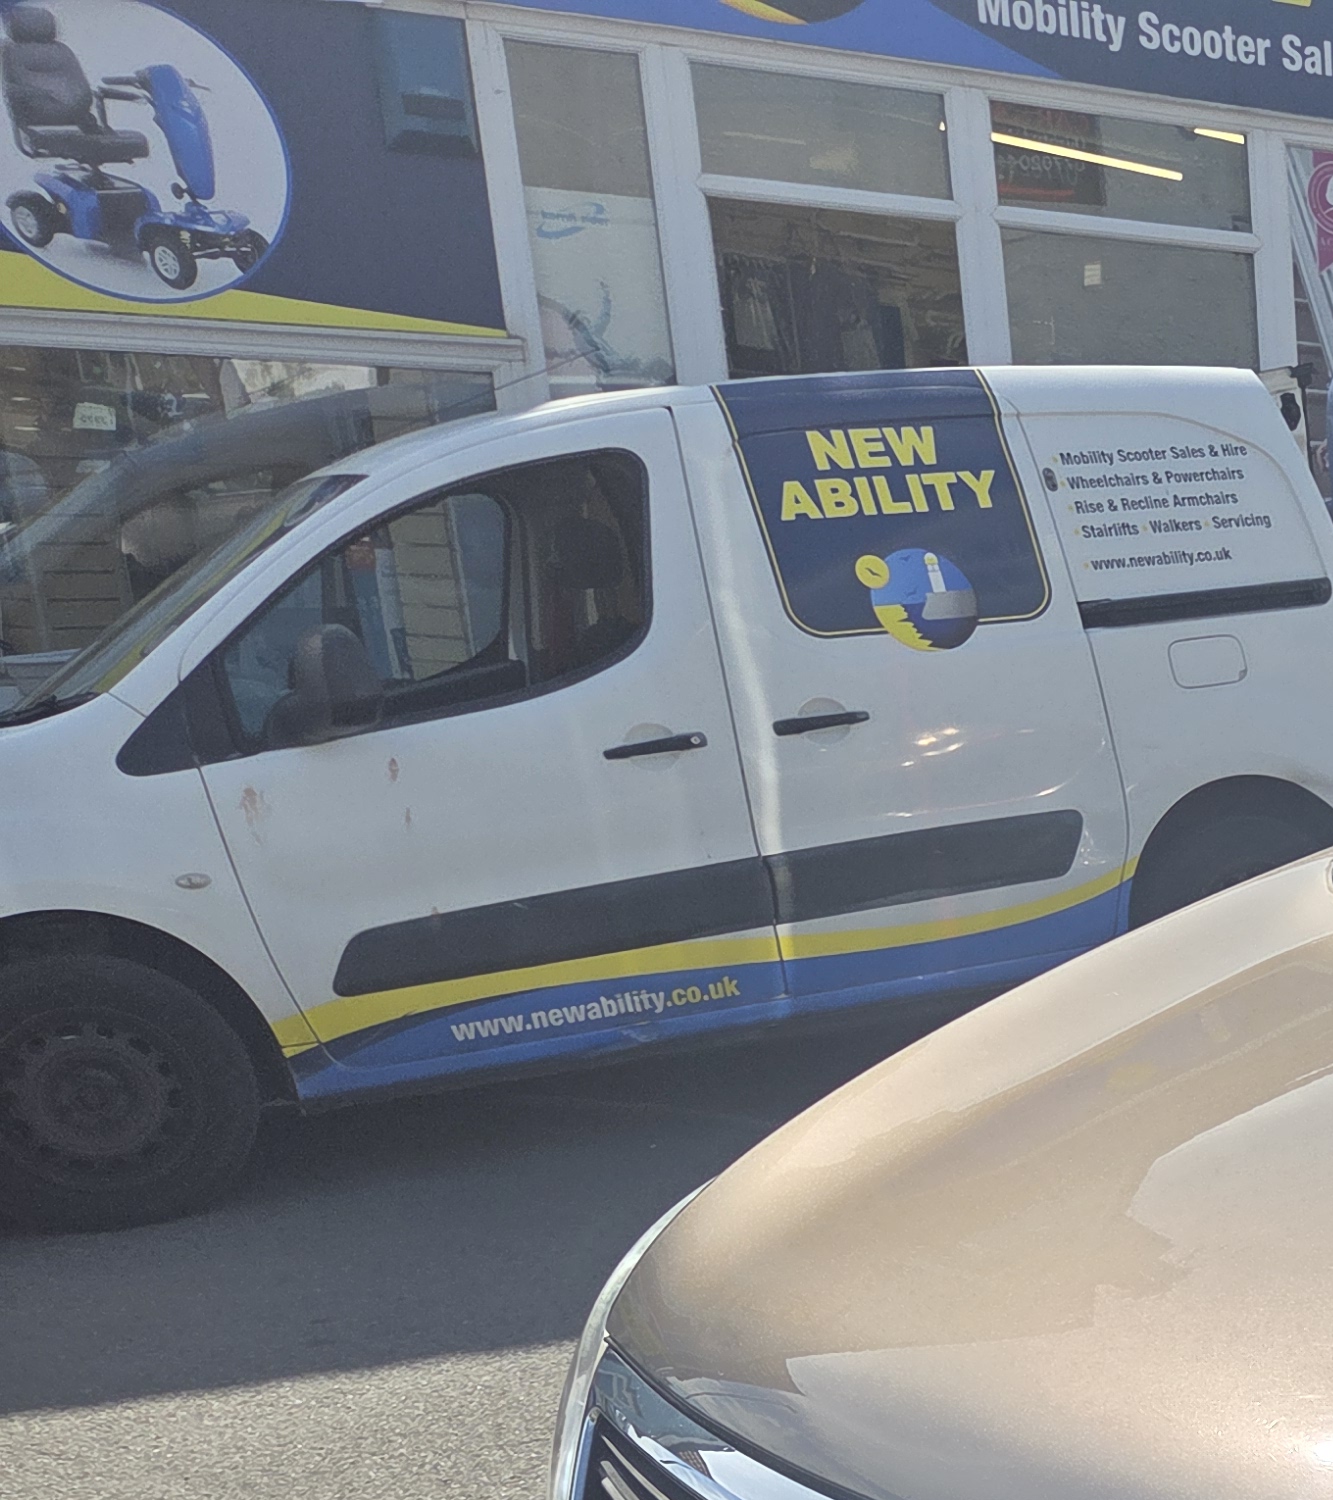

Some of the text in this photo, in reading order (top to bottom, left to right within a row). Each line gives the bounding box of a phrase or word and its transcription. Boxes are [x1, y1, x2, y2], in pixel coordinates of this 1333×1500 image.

[978, 0, 1126, 51] Mobility
[1138, 11, 1271, 66] Scooter
[805, 426, 936, 471] NEW
[1059, 443, 1248, 466] Mobility Scooter Sales & Hire
[1067, 467, 1244, 490] Wheelchairs & Powerchairs
[781, 470, 995, 521] ABILITY
[1074, 491, 1239, 514] Rise & Recline Armchairs
[1082, 513, 1272, 538] Stairlifts Walkers Servicing
[1090, 546, 1233, 571] www.newability.co.uk
[451, 976, 741, 1042] www.newability.co.uk
